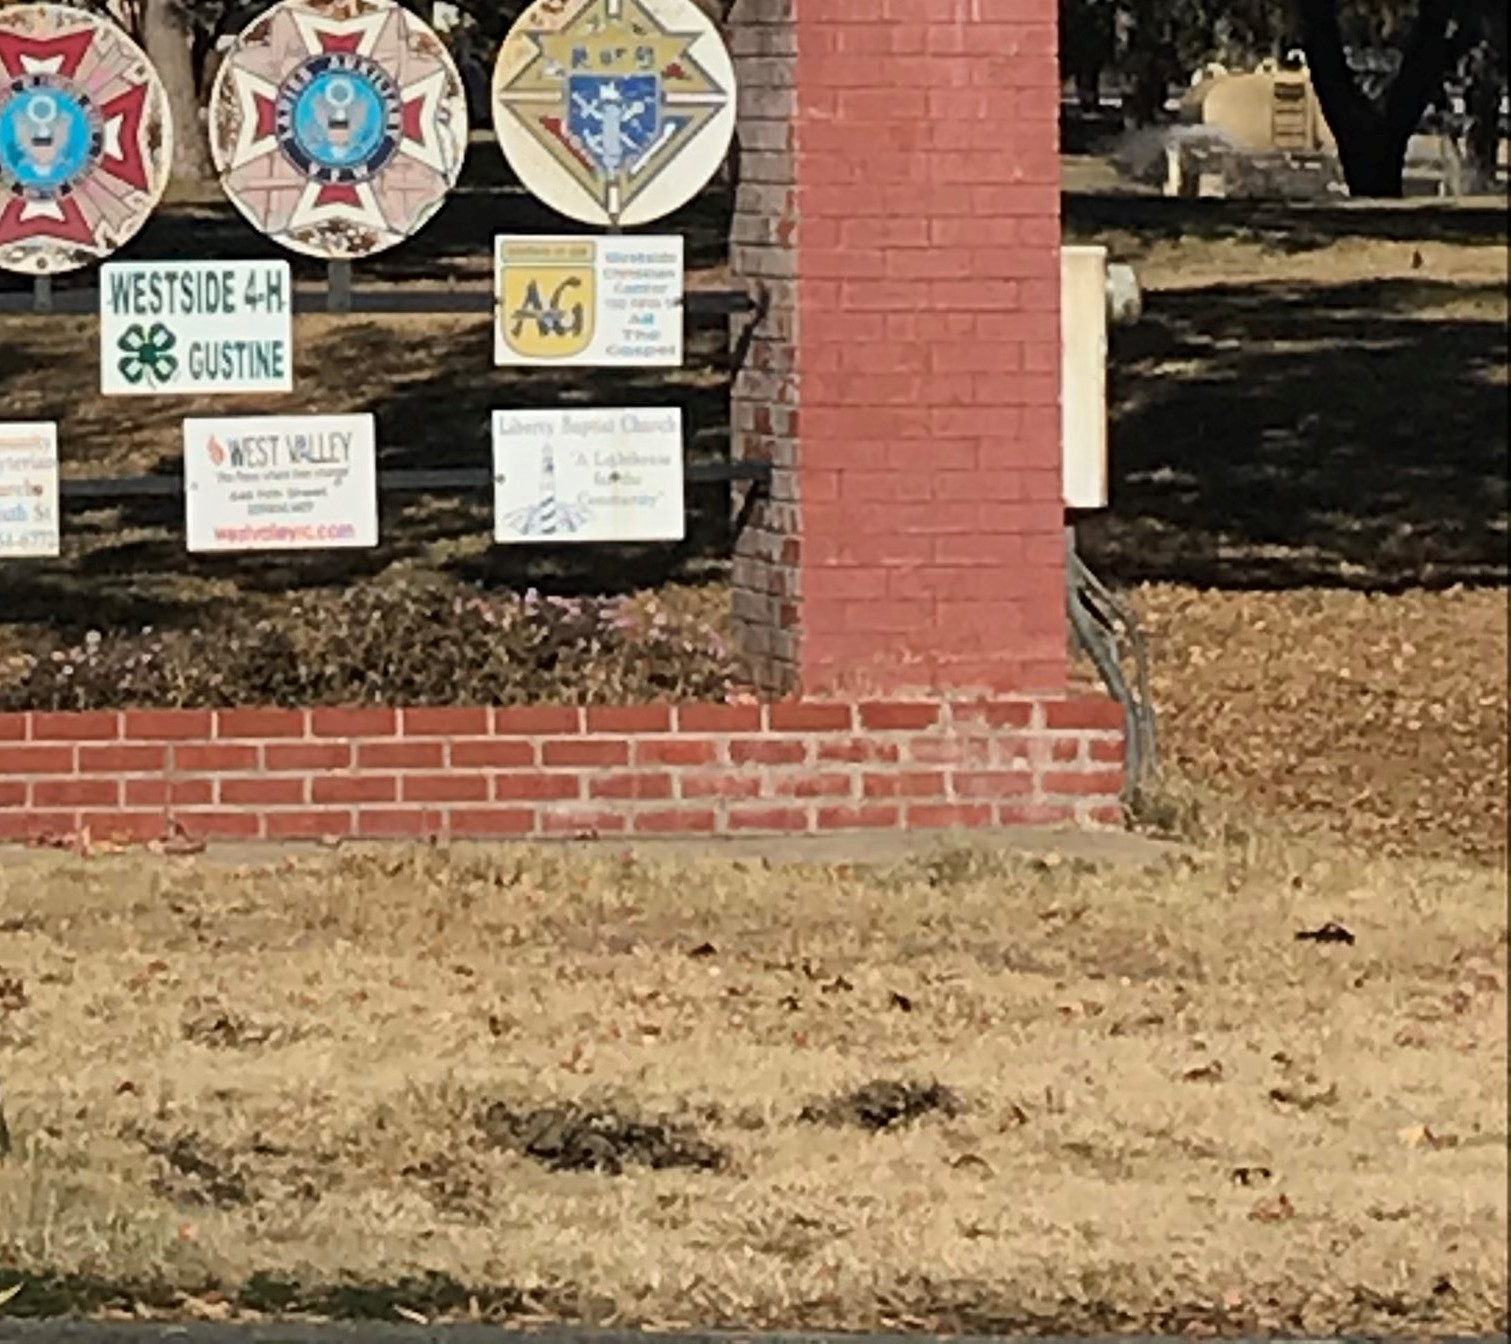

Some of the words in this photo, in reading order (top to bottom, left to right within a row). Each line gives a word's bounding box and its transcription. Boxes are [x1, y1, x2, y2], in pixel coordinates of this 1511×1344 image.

[110, 271, 236, 315] WESTSIDE
[188, 340, 285, 381] GUSTINE
[228, 435, 279, 467] WEST
[286, 431, 353, 464] VALLEY
